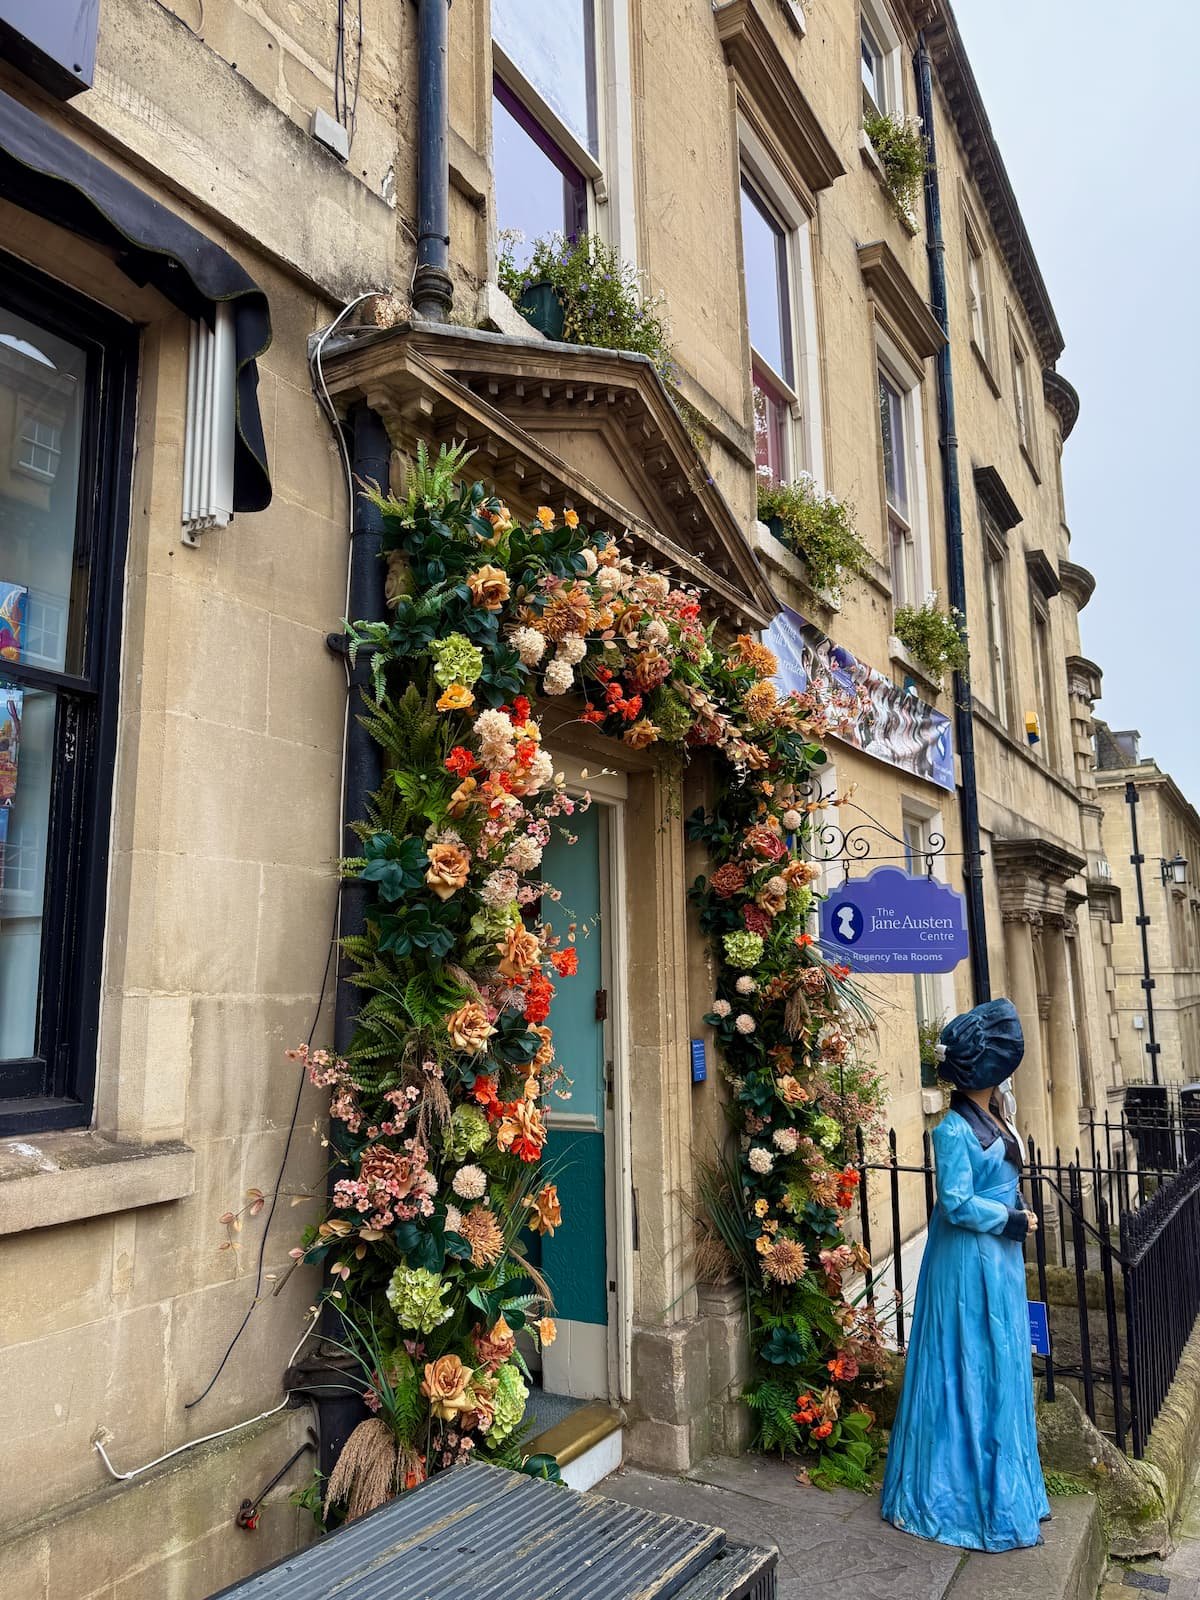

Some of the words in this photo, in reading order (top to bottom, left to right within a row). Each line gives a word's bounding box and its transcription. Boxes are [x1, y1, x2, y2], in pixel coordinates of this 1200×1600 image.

[876, 907, 895, 917] The
[869, 915, 901, 932] Jane
[901, 915, 954, 929] Austen
[919, 931, 955, 941] Centre
[853, 953, 890, 963] Regency
[892, 952, 908, 961] Tea
[910, 952, 943, 961] Rooms
